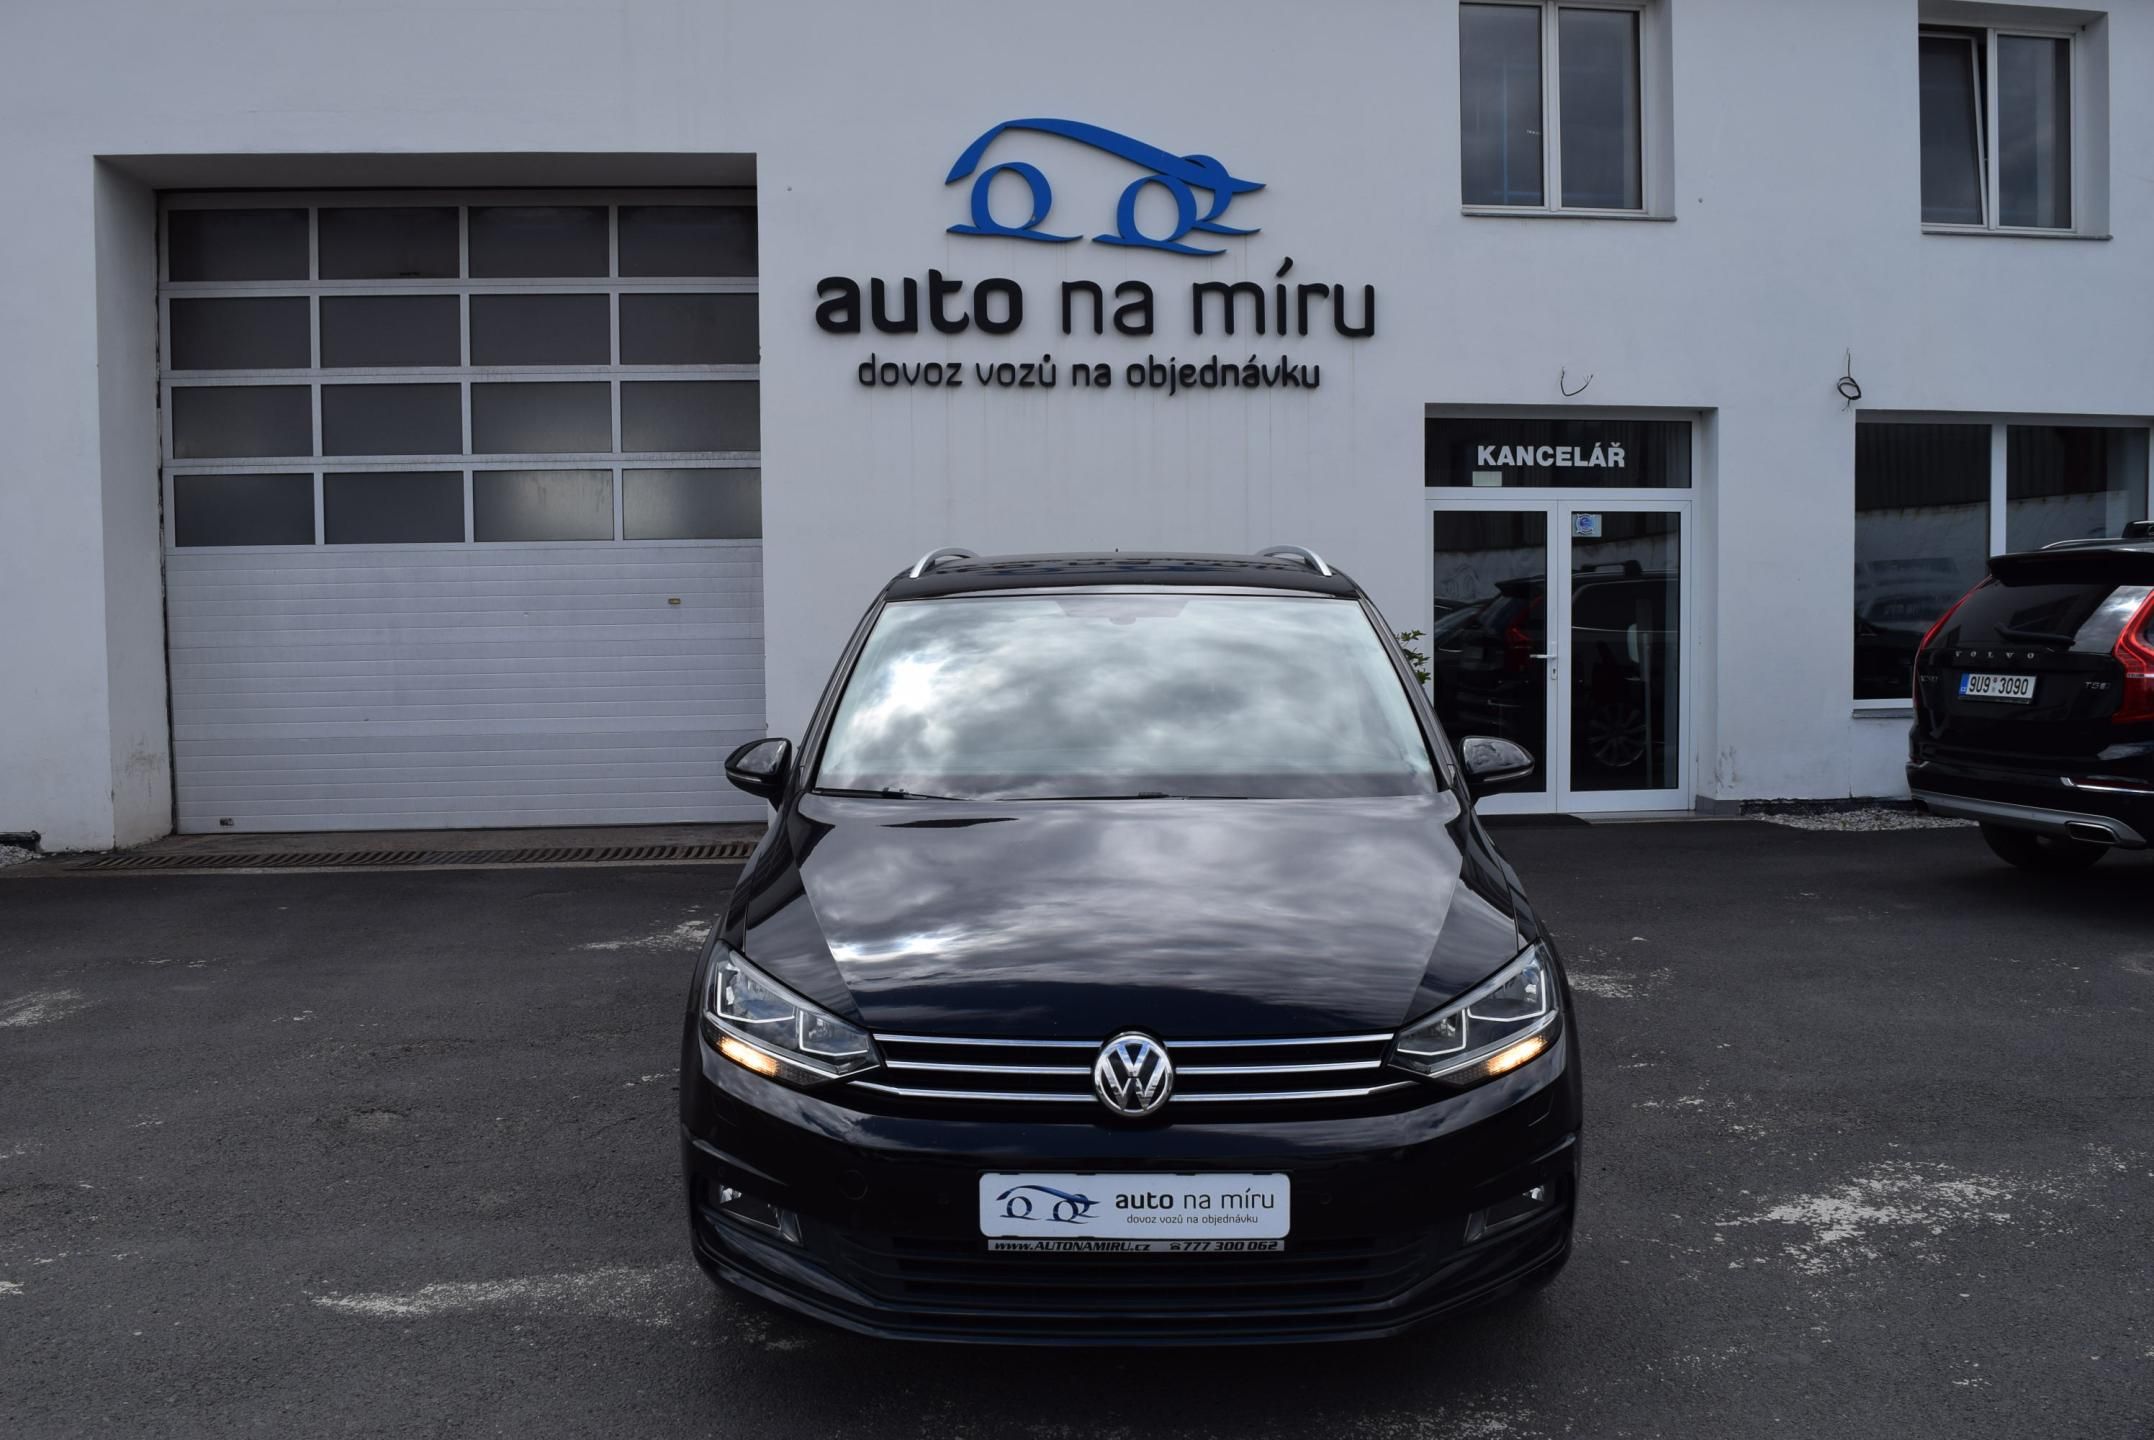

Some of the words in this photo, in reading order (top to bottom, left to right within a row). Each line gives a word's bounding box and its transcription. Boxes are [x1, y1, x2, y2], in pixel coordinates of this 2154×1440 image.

[815, 268, 1024, 335] auto
[1061, 280, 1155, 336] na
[1192, 256, 1376, 338] míru
[857, 353, 963, 387] dovoz
[975, 353, 1057, 388] vozů
[1071, 361, 1112, 388] na
[1126, 354, 1321, 396] objednávku
[1477, 442, 1625, 468] KANCELÁŘ
[1955, 650, 2035, 660] VOLVO
[1968, 676, 1991, 693] 9U9
[1998, 677, 2029, 695] 3090
[1115, 1192, 1174, 1210] auto
[1183, 1194, 1211, 1209] na
[1221, 1187, 1274, 1209] míru
[1127, 1214, 1157, 1224] dovoz
[1160, 1214, 1183, 1224] vozů
[1186, 1216, 1199, 1224] na
[1201, 1214, 1258, 1226] objednávku
[1183, 1241, 1211, 1251] 777
[1214, 1241, 1245, 1251] 300
[1247, 1241, 1278, 1251] 062
